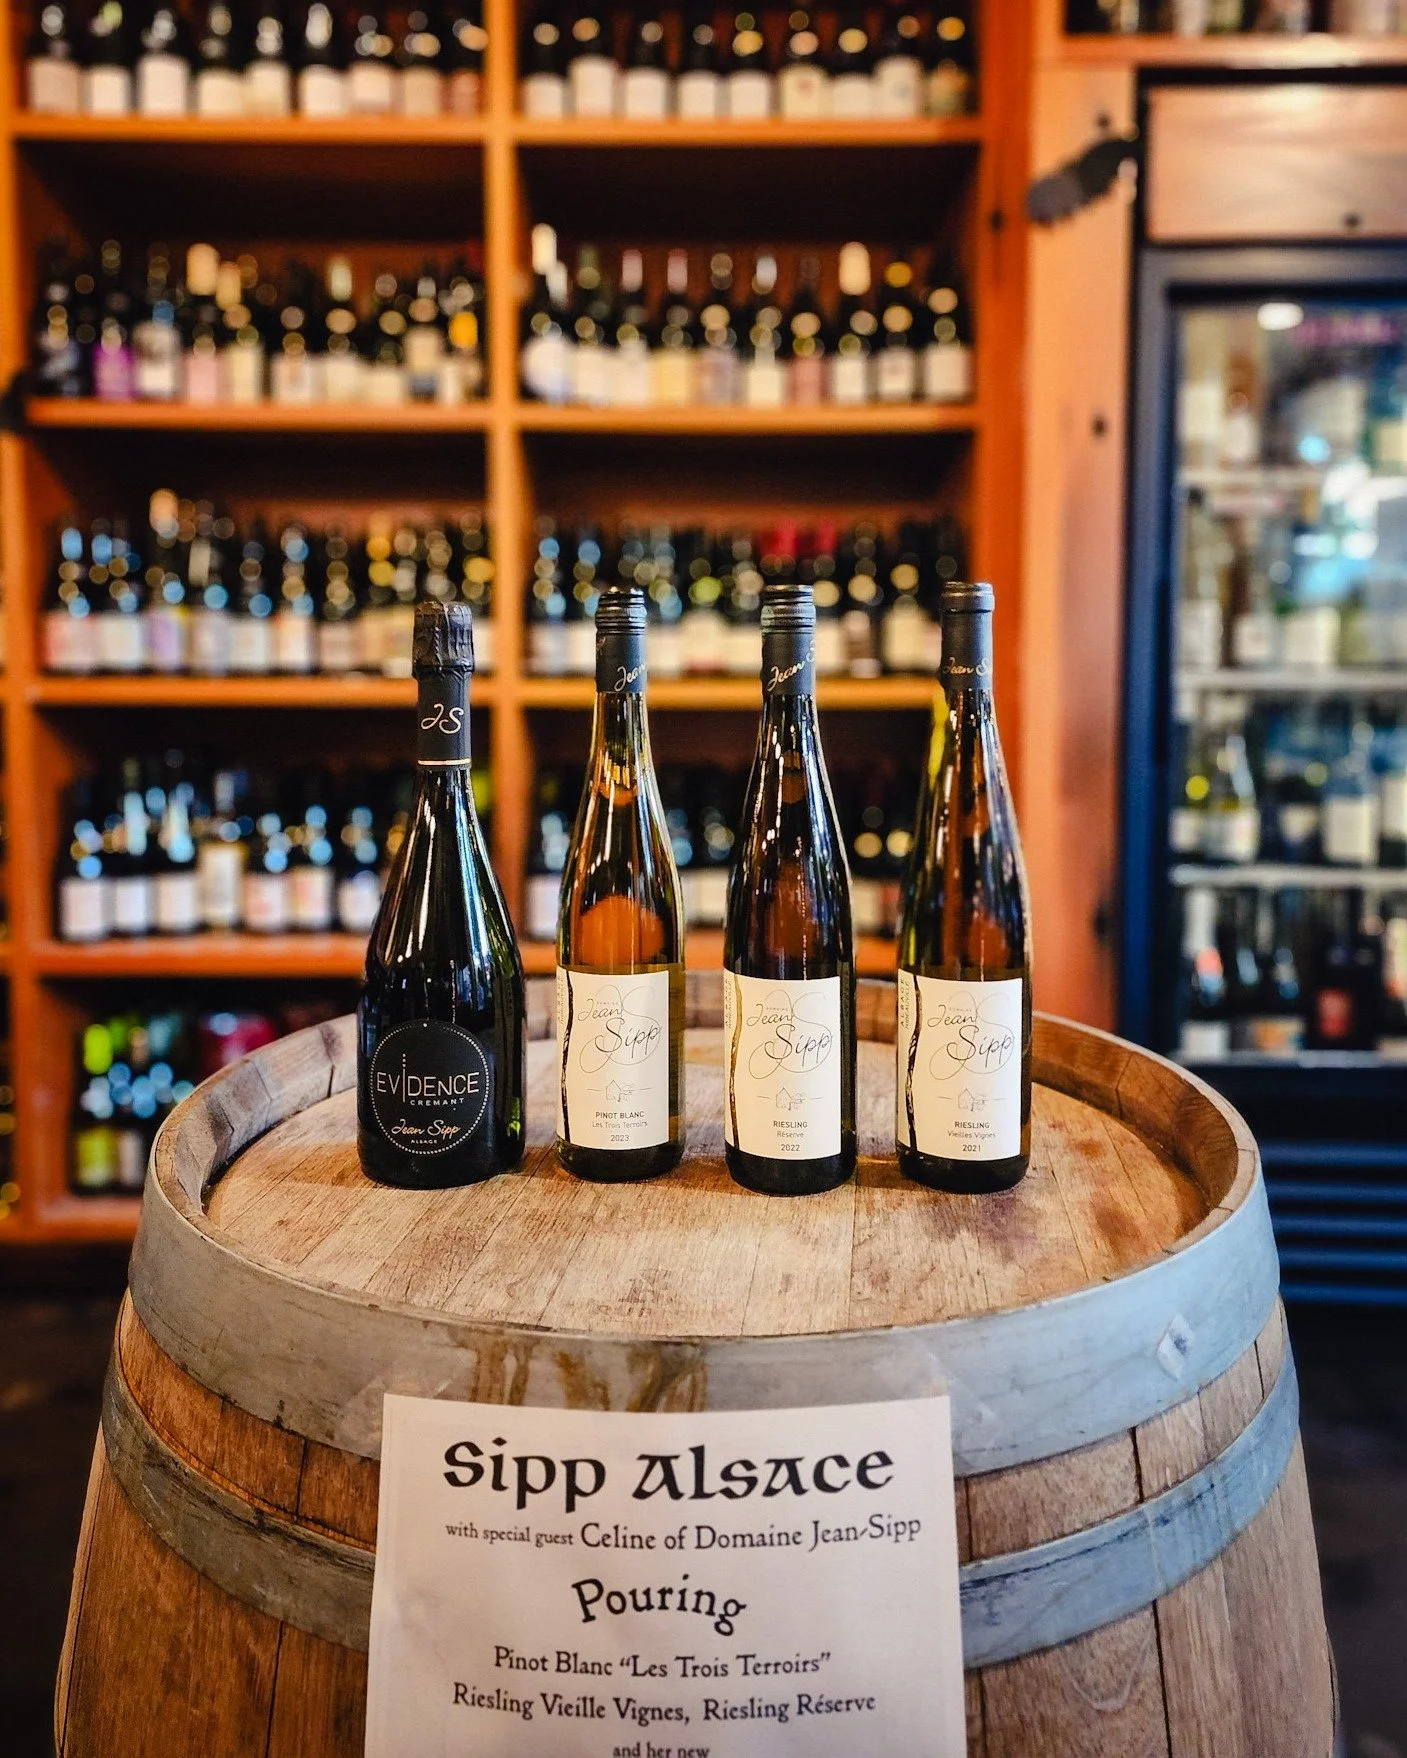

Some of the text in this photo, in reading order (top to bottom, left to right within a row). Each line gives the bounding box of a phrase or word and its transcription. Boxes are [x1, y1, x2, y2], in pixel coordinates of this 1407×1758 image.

[766, 660, 805, 692] Jean
[577, 998, 623, 1021] Jean
[746, 1003, 794, 1027] Jean
[927, 1004, 978, 1028] Jean
[594, 1017, 663, 1059] Sipp
[764, 1023, 833, 1067] Sipp
[946, 1024, 1015, 1068] Sipp
[376, 1067, 480, 1102] EVIDENCE
[409, 1098, 465, 1106] CREMANT
[595, 1110, 645, 1119] PINOT BLANC
[605, 1121, 621, 1129] Trois
[622, 1120, 648, 1129] Terroirs
[772, 1120, 808, 1129] RIESLING
[954, 1121, 990, 1129] RIESLING
[391, 1118, 461, 1140] Jean Sipp
[610, 1134, 630, 1142] 2023
[781, 1143, 801, 1152] 2022
[962, 1144, 982, 1152] 2021
[443, 1437, 894, 1513] Sipp Alsace
[446, 1513, 922, 1552] with special guest Celine of Domaine Jean-Sipp
[571, 1573, 747, 1637] Pouring
[494, 1645, 831, 1678] Pinot Blanc “Les Trois Terroirs”
[452, 1682, 876, 1726] Riesling Vieille Vignes, Riesling Réserve
[612, 1741, 710, 1758] and her new
